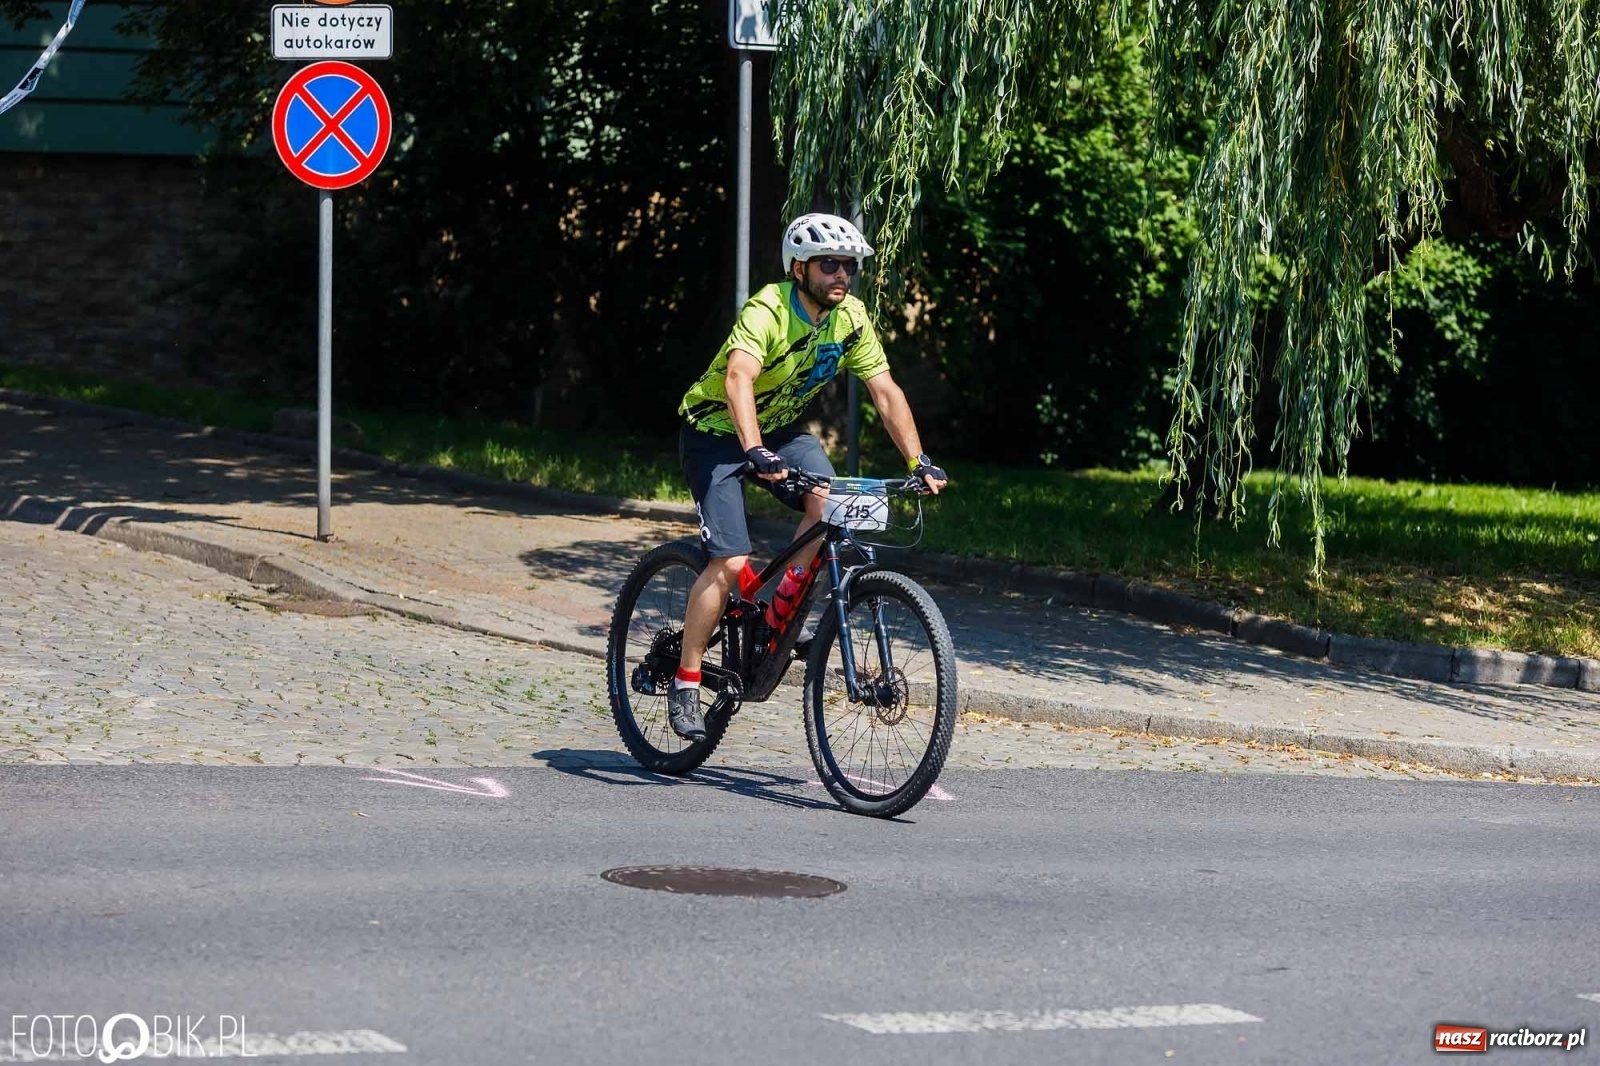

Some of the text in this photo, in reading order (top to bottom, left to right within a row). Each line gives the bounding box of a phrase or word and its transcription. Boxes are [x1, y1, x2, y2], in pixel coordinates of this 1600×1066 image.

[281, 12, 383, 32] Nie dotyczy
[283, 34, 375, 49] autokarów
[844, 504, 870, 519] 215
